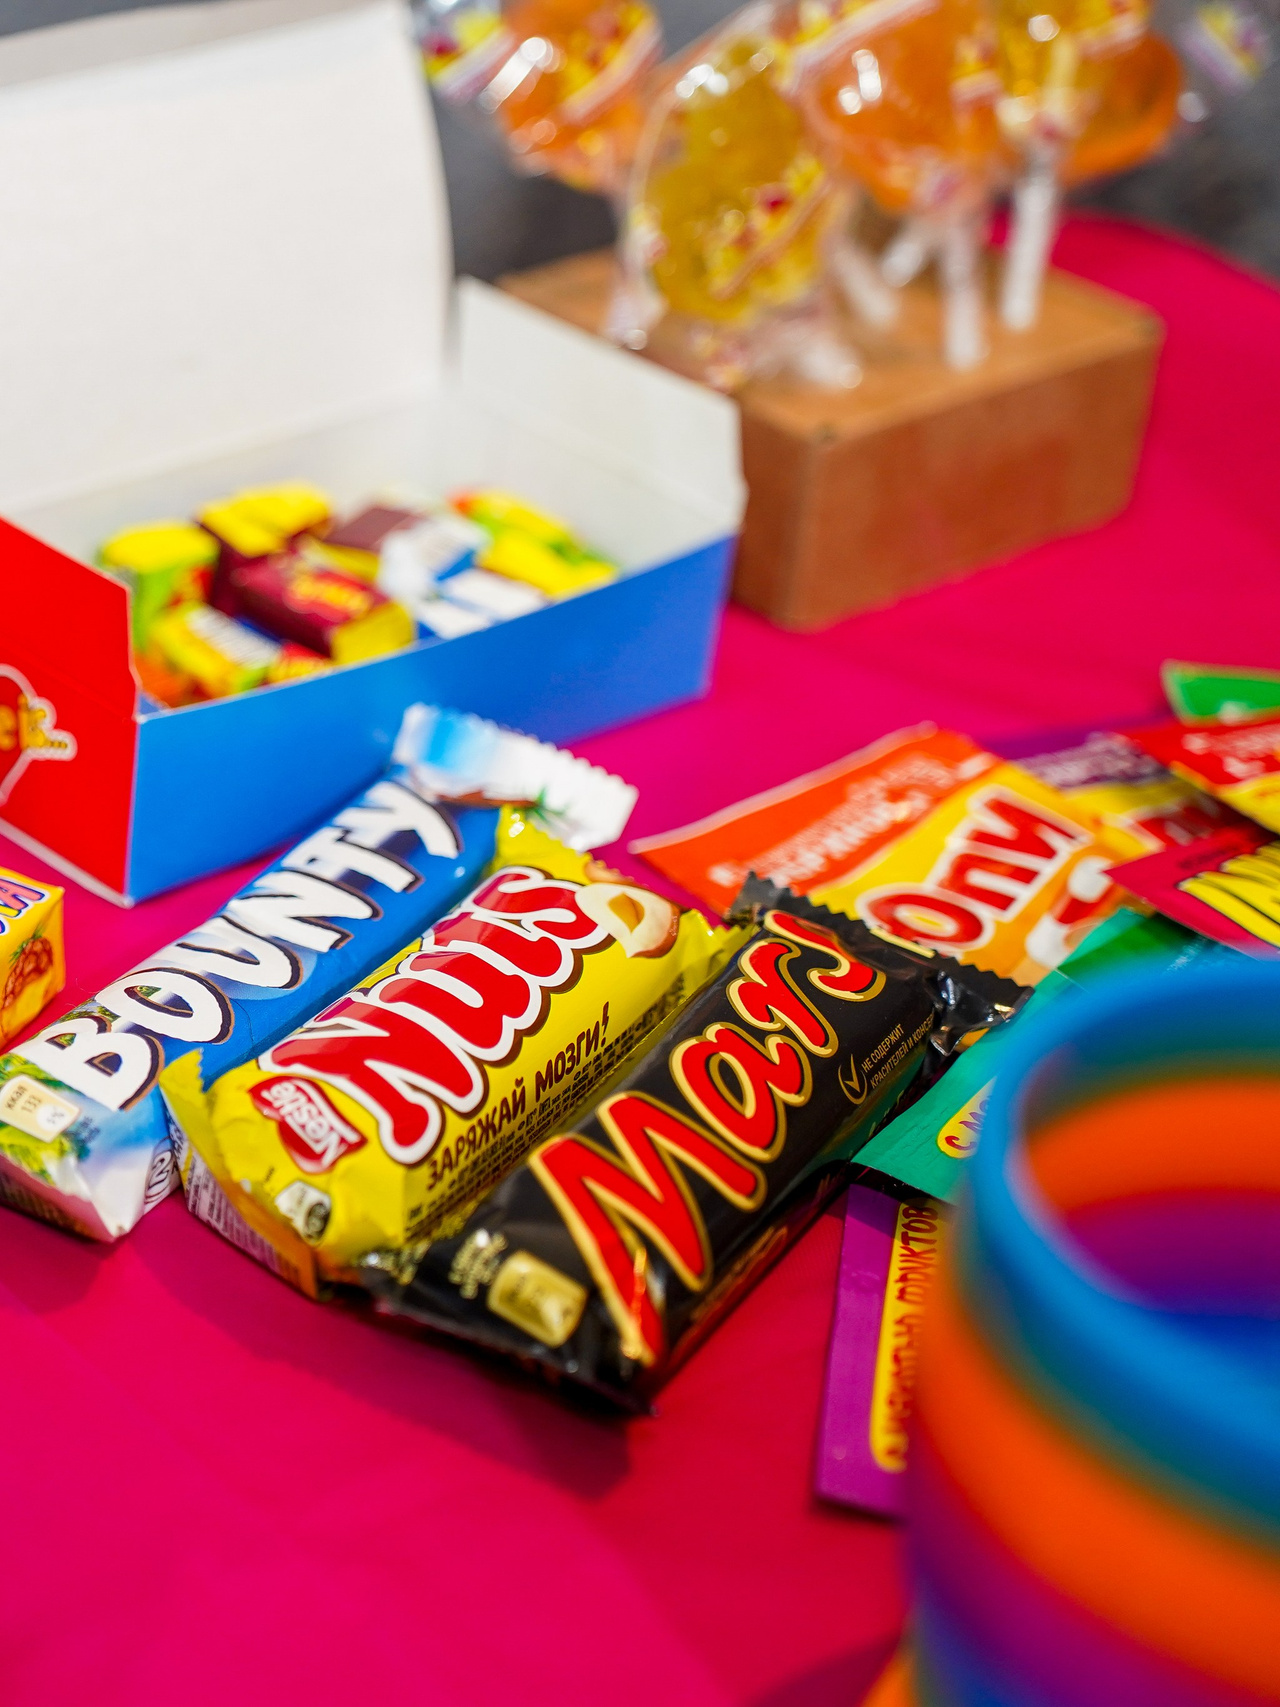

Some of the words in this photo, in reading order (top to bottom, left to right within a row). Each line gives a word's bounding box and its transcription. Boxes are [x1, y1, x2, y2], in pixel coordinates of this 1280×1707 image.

[11, 780, 461, 1112] BOUNTY
[258, 866, 608, 1167] Nuts
[861, 1057, 874, 1073] НЕ
[870, 1023, 905, 1063] СОДЕРЖИТ
[870, 1041, 909, 1089] КРАСИТЕЛЕЙ
[427, 1076, 527, 1192] ЗАРЯЖАЙ
[535, 1001, 610, 1099] МОЗГИ!
[528, 907, 887, 1367] Mars
